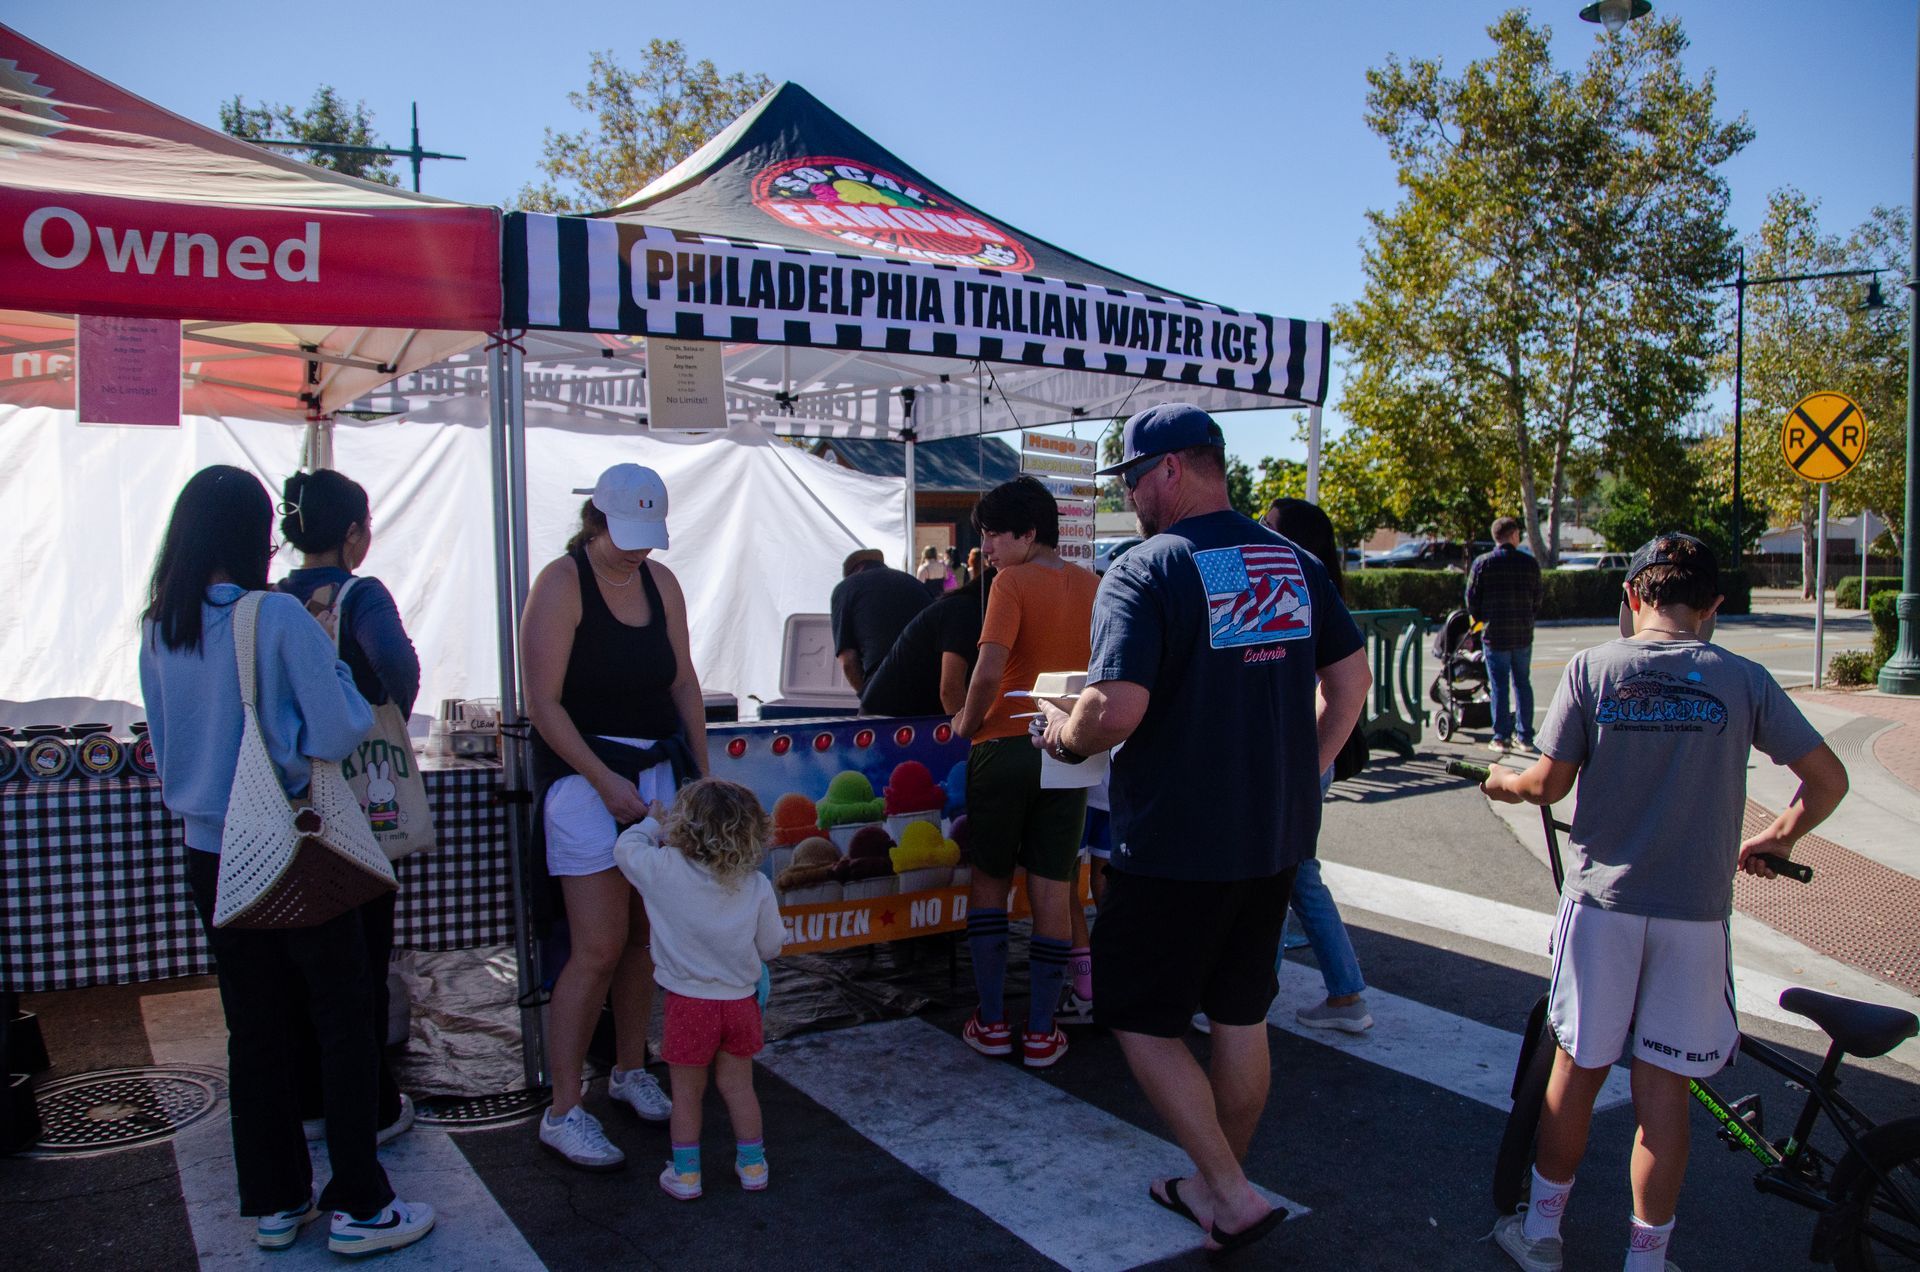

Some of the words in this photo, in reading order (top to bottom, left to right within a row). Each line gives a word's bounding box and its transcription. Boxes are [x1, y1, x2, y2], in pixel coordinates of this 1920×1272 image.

[775, 166, 829, 193] SO
[834, 165, 927, 203] CAL
[769, 203, 1006, 244] FAMOUS
[22, 206, 321, 283] Owned
[645, 248, 945, 324] PHILADELPHIA
[953, 280, 1088, 341] ITALIAN
[1095, 300, 1204, 358] WATER
[1210, 319, 1259, 366] ICE
[666, 396, 678, 404] No
[1028, 432, 1077, 454] Mango
[1789, 428, 1805, 449] R
[1842, 425, 1859, 448] R
[639, 499, 653, 509] U
[470, 718, 495, 730] CLEAN
[781, 908, 871, 946] GLUTEN
[910, 897, 942, 929] NO
[1642, 1037, 1682, 1059] WEST
[1686, 1049, 1720, 1062] ELITE
[1696, 1089, 1729, 1122] DEVICE
